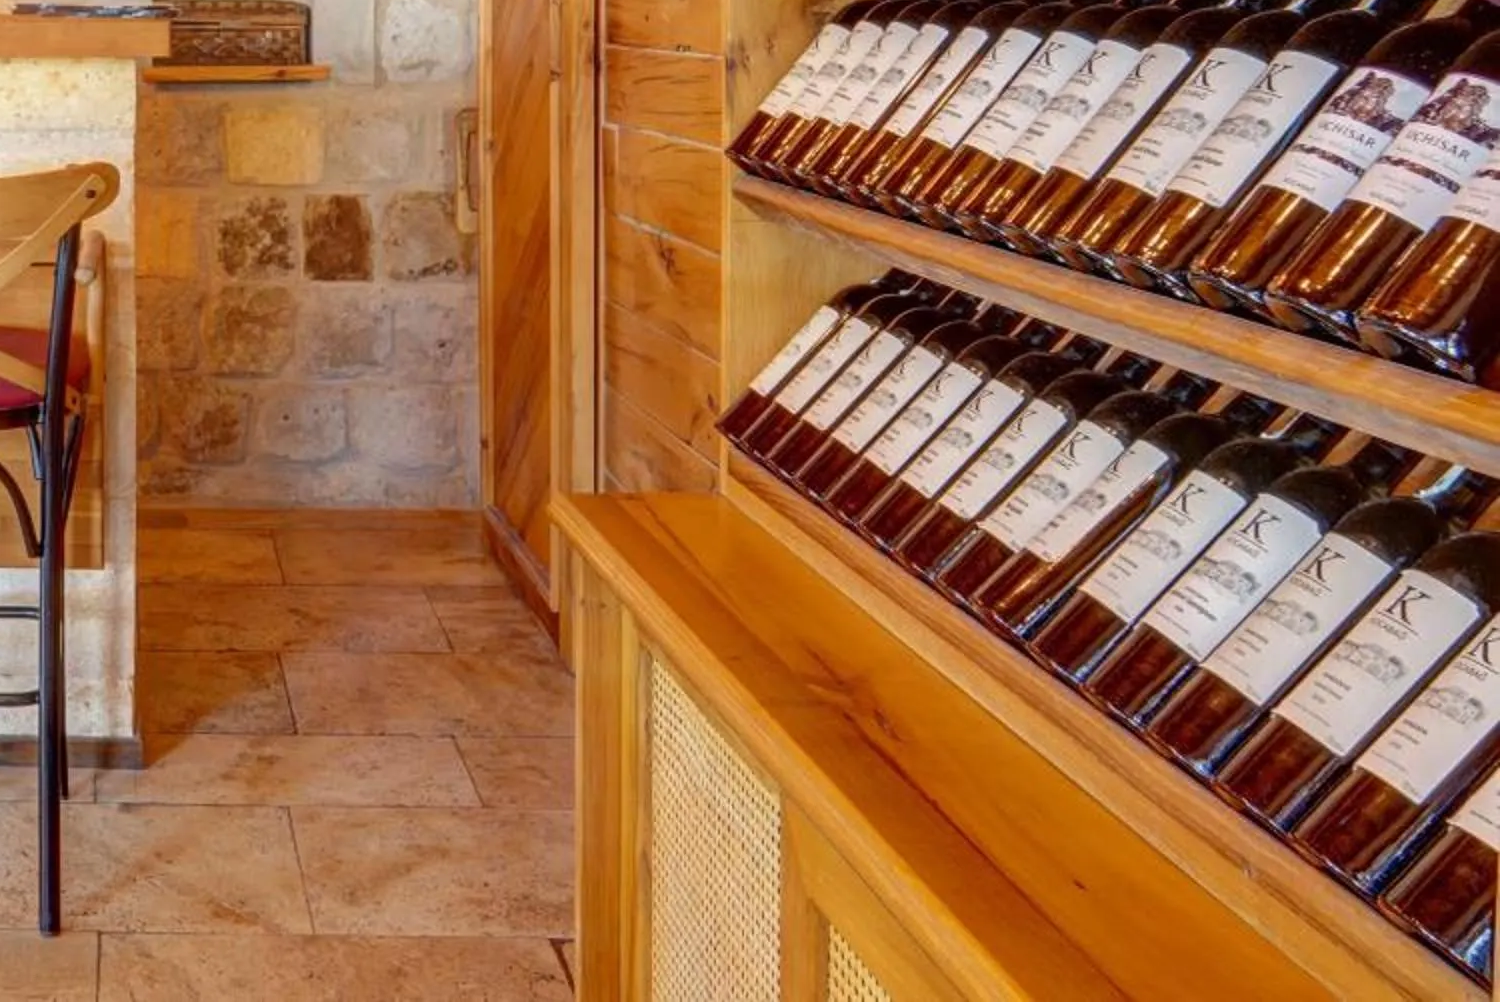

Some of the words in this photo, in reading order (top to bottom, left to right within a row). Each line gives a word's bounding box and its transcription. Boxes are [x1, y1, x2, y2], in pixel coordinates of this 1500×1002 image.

[1253, 62, 1294, 93] K
[1169, 482, 1207, 515] K
[1238, 508, 1282, 545] K
[1302, 547, 1347, 584] K
[1384, 584, 1433, 627] K
